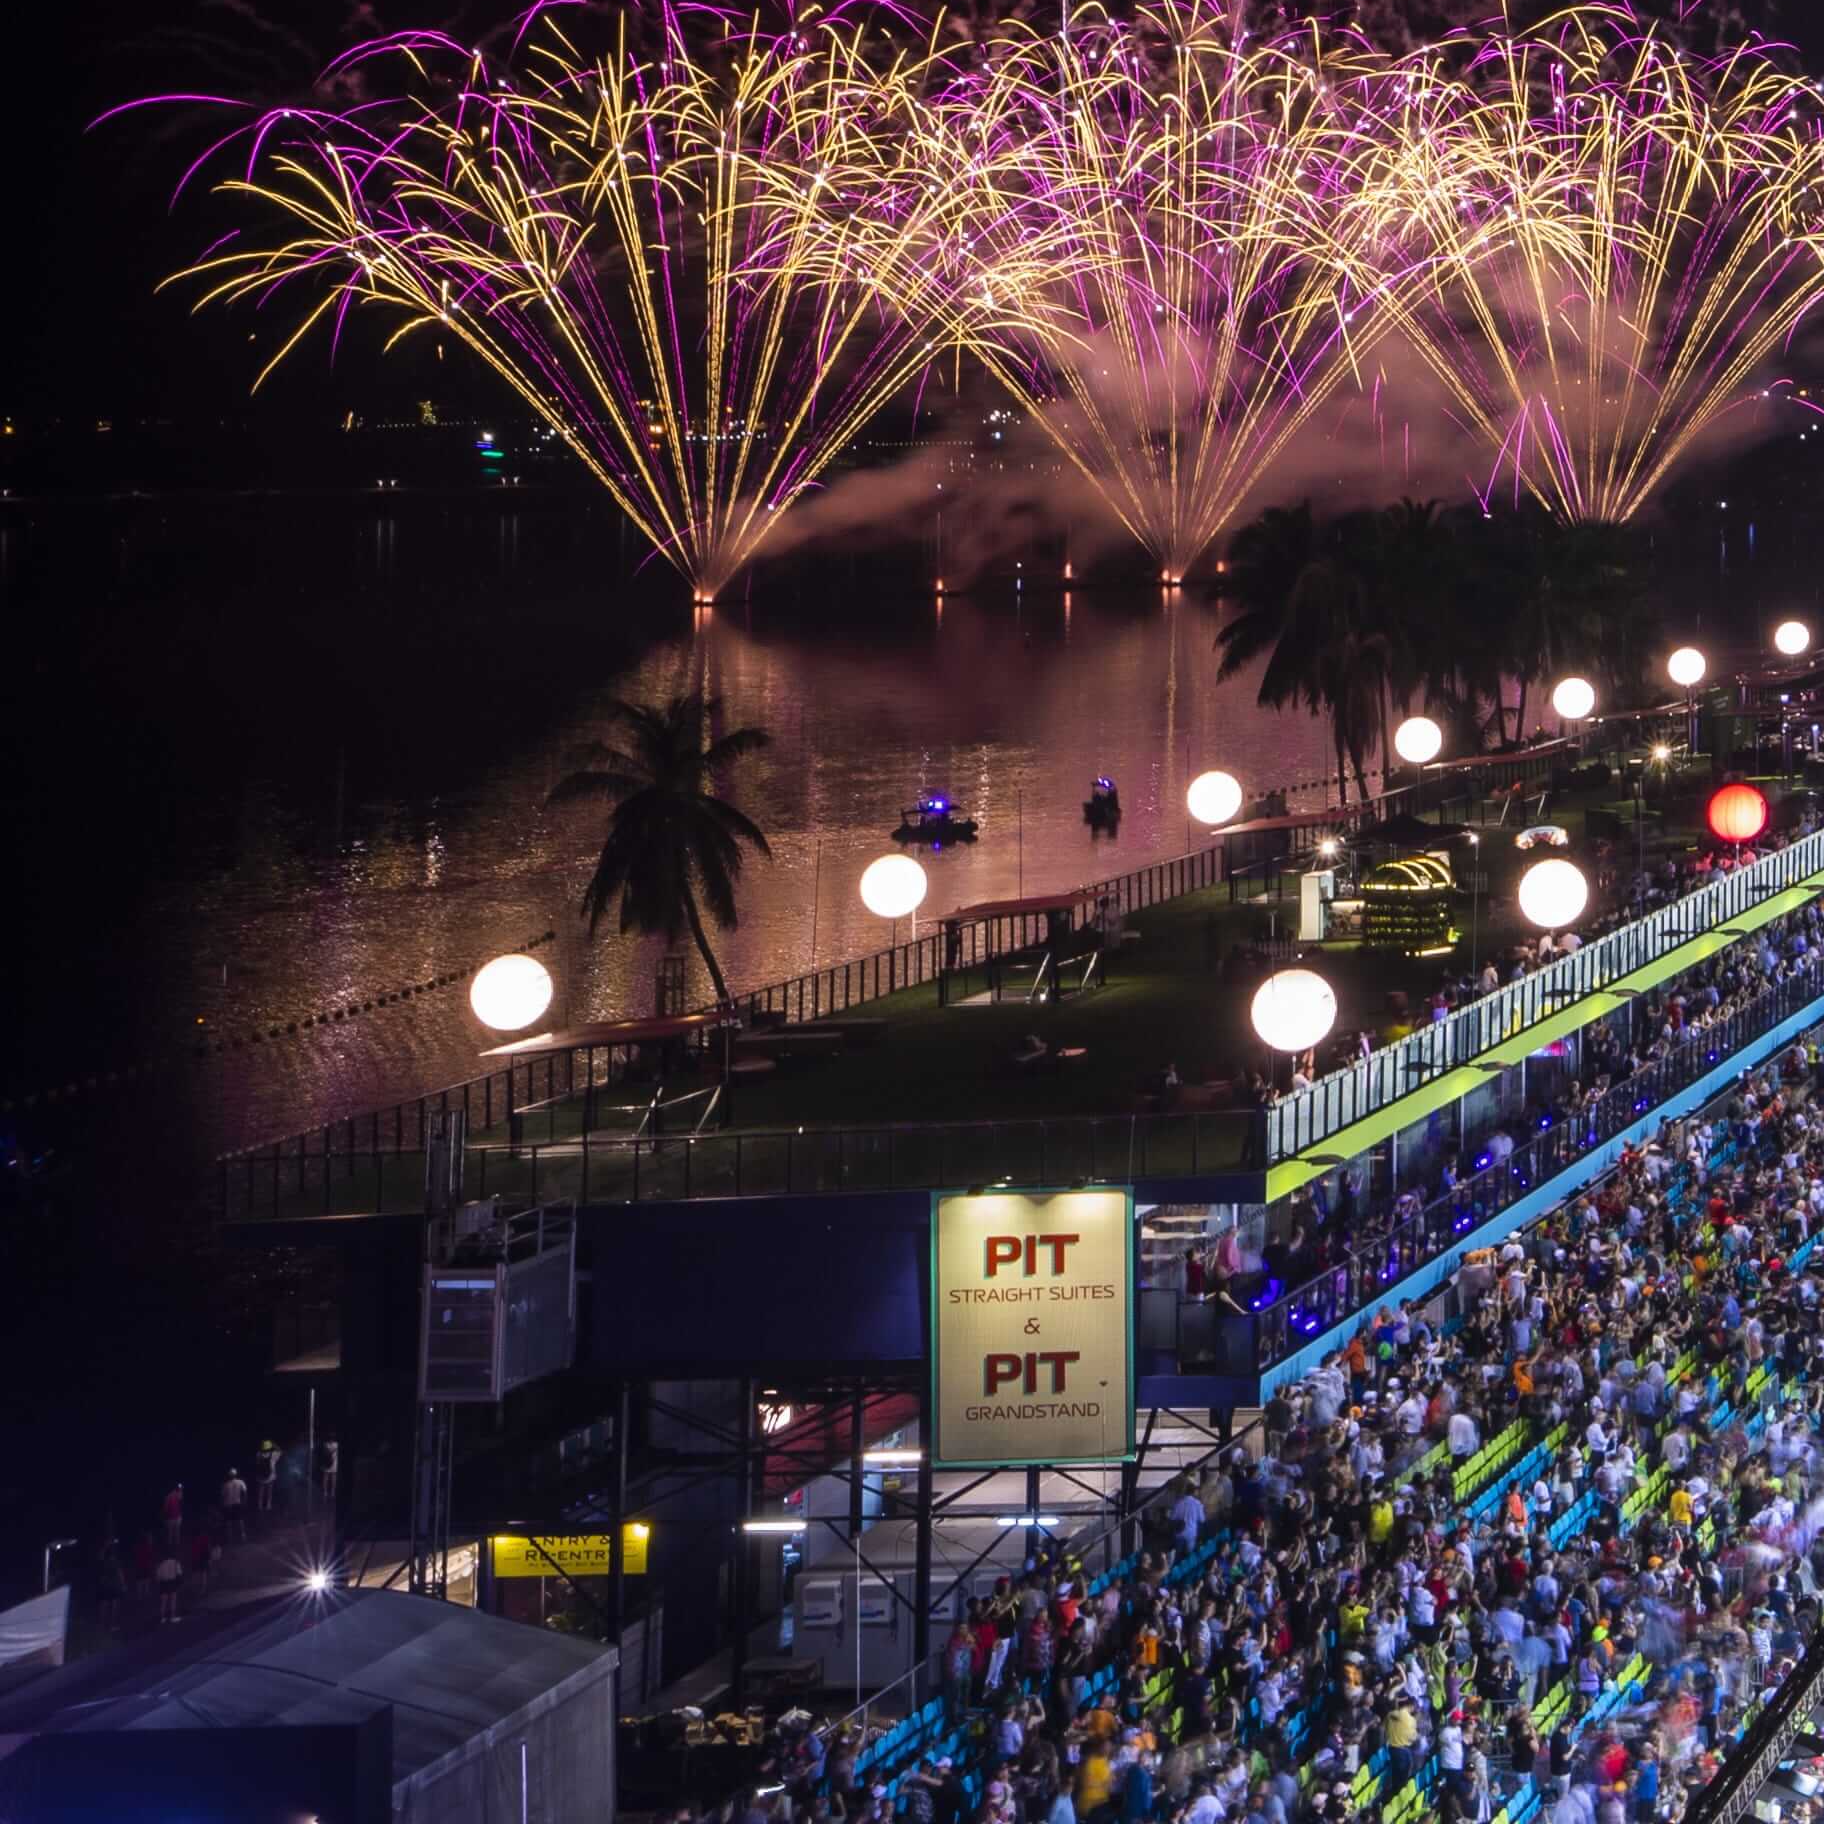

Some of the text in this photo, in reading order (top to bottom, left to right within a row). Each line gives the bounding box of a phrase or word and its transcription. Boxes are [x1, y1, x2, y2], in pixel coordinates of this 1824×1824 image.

[984, 1233, 1080, 1279] PIT
[949, 1284, 1115, 1304] STRAIGHT SUITES
[1023, 1317, 1041, 1335] &
[984, 1351, 1081, 1397] PIT
[966, 1402, 1100, 1421] GRANDSTAND
[529, 1536, 590, 1546] NTRY
[525, 1549, 610, 1561] RE-ENTR
